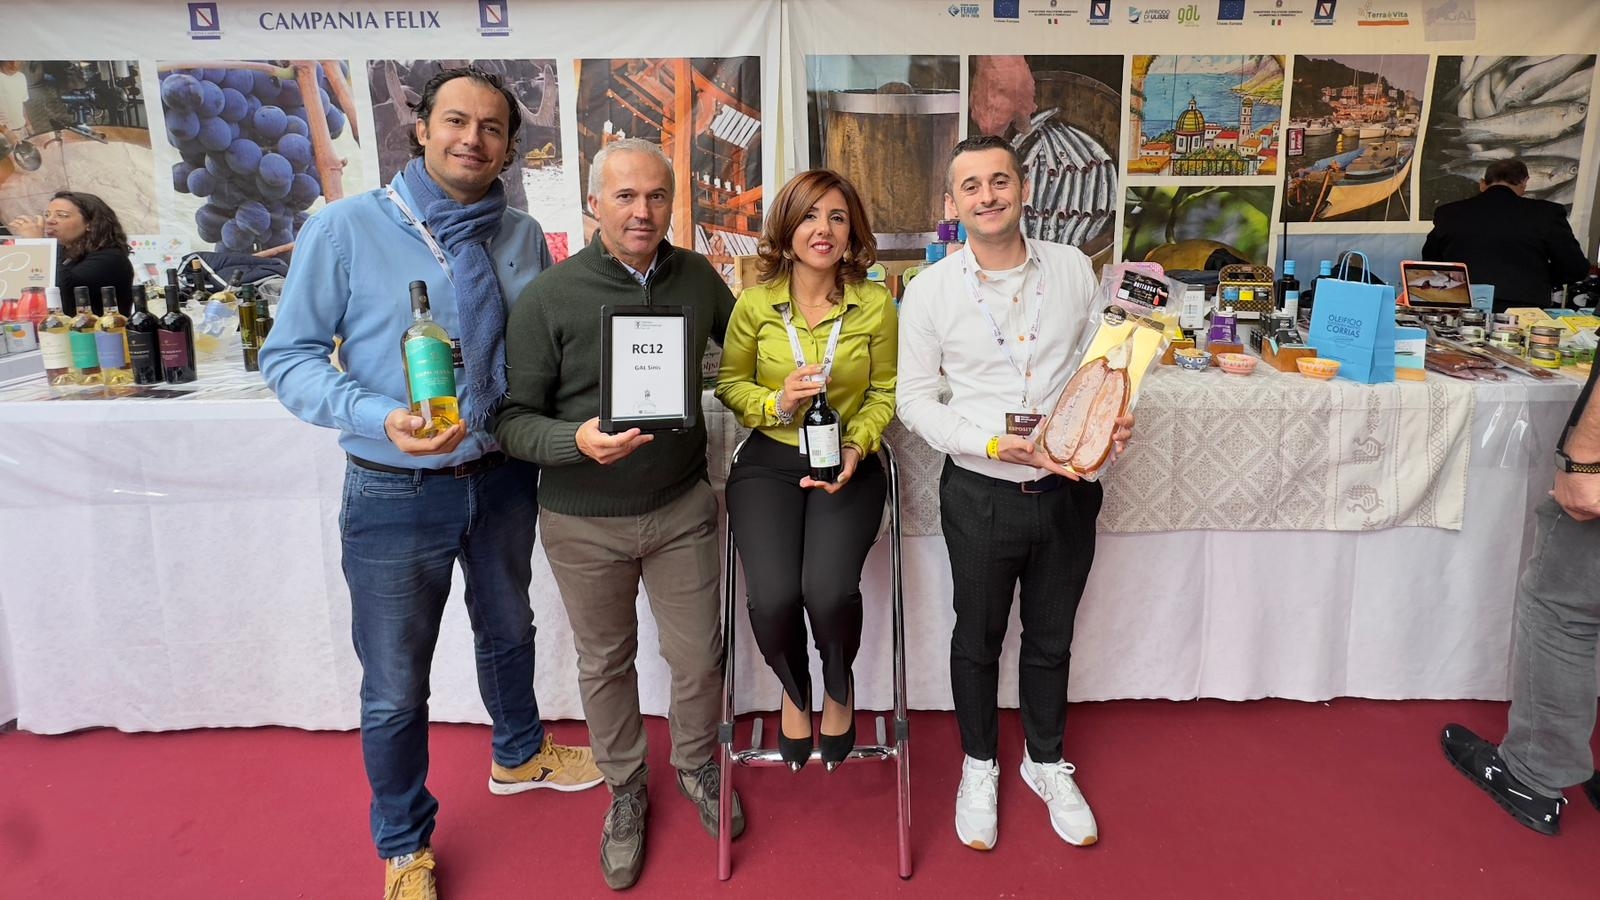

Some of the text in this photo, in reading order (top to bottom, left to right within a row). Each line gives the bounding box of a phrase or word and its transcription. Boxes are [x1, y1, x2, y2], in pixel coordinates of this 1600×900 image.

[259, 10, 441, 30] CAMPANIA FELIX
[1328, 314, 1362, 326] OLEIFICIO
[1326, 324, 1360, 338] CORRIAS
[632, 343, 664, 354] RC12
